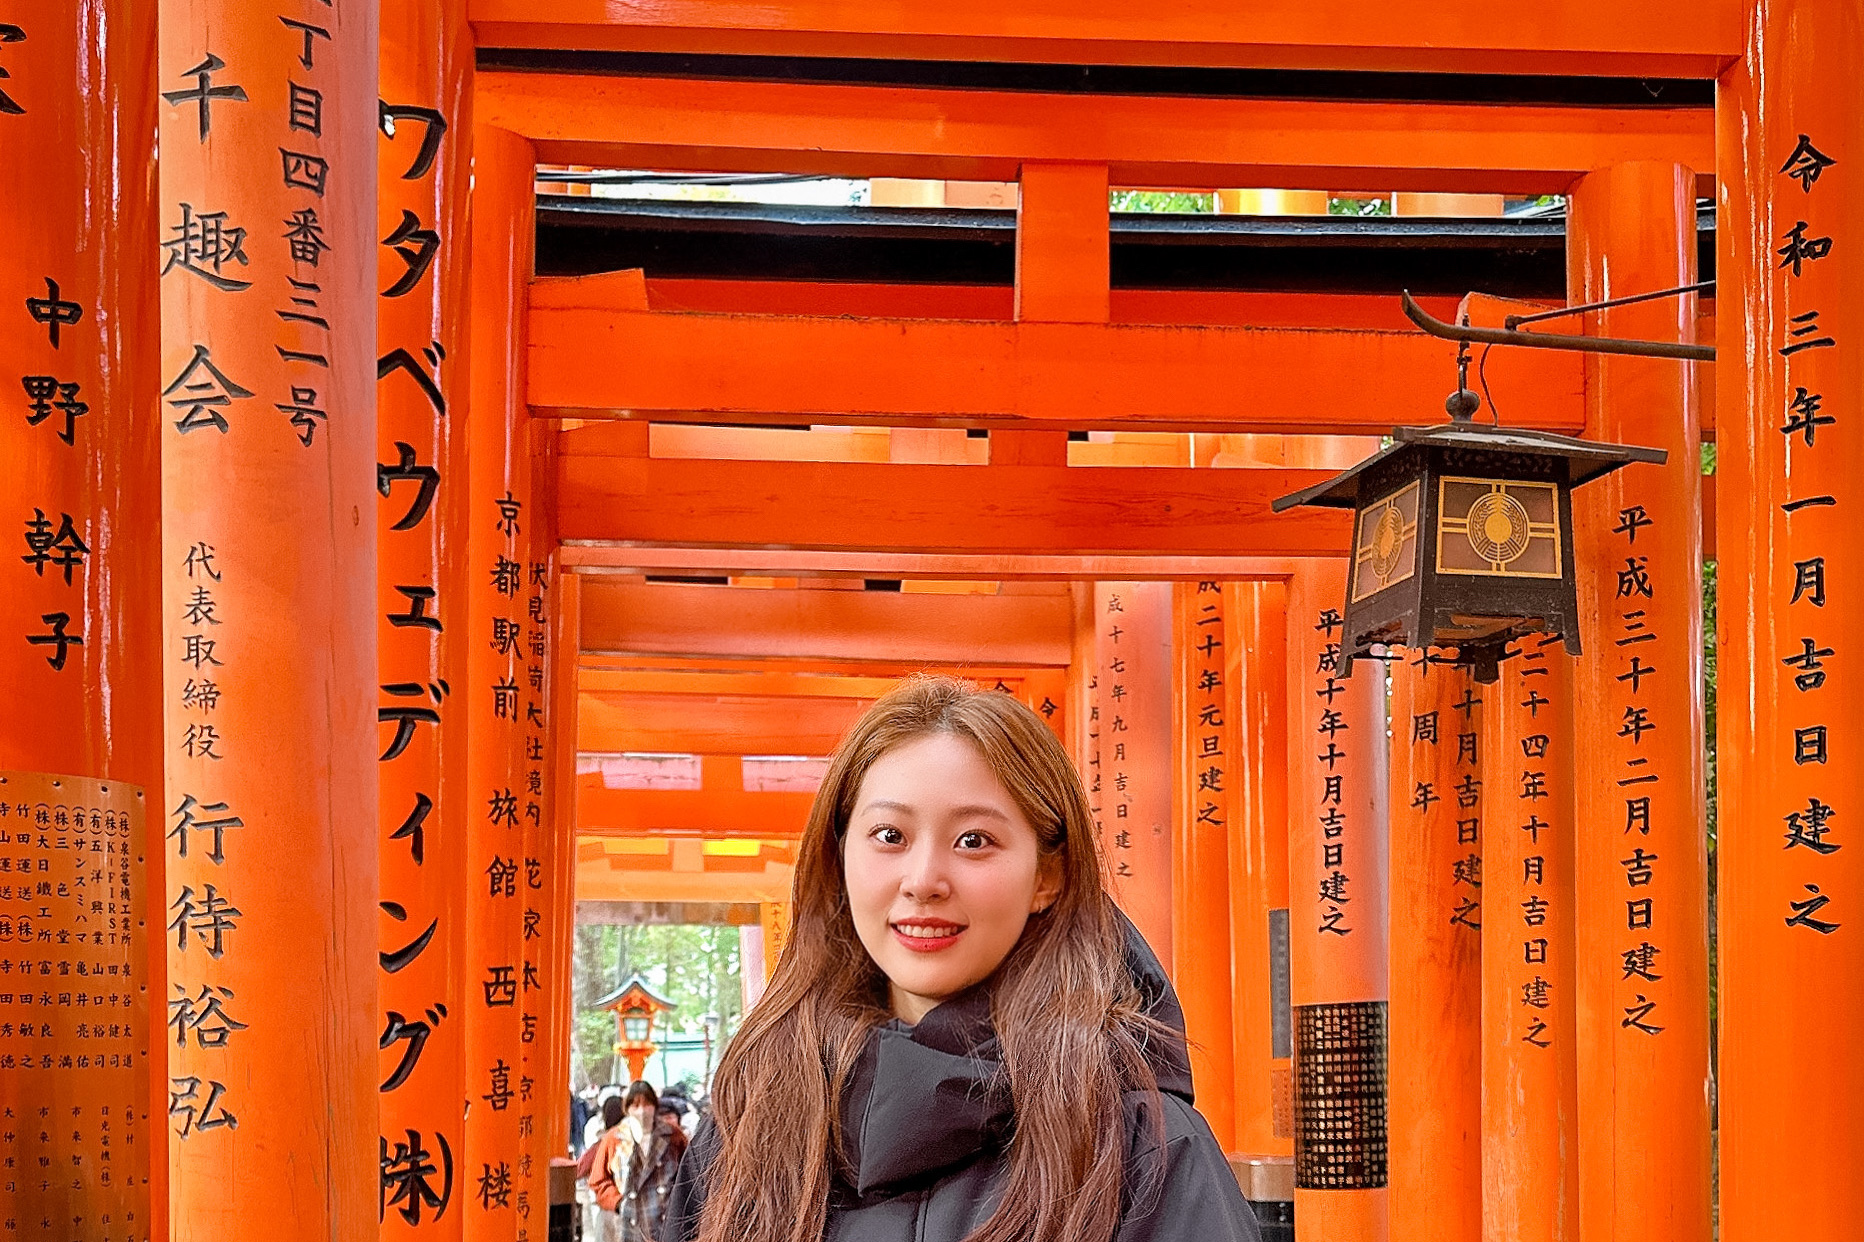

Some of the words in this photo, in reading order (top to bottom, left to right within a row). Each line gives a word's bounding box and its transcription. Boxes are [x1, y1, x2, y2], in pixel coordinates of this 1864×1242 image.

[161, 53, 254, 432] 千趣会
[276, 0, 332, 447] 丁目四番三一号
[22, 277, 89, 446] 中野
[22, 508, 91, 671] 幹子
[491, 492, 522, 722] 京都駅前
[1777, 135, 1841, 934] 令和三年一月吉日建之
[183, 542, 221, 758] 代表取締役
[378, 99, 453, 1226] ワタベウェディング株)
[1107, 594, 1133, 878] 成十七年九月吉日建之
[16, 804, 33, 943] 竹田運送(株)
[54, 804, 70, 944] (株)三色堂
[89, 808, 103, 945] (有)五洋興業
[488, 789, 518, 896] 旅館
[1314, 608, 1352, 936] 平成十年十月吉日建之
[1518, 652, 1552, 1049] 二十四年十月吉日建之
[1613, 506, 1662, 1034] 平成三十年二月吉日建之
[19, 960, 34, 1068] 竹田敏之
[38, 960, 54, 1068] 富永良吾
[93, 962, 105, 1068] 山口裕司
[108, 964, 120, 1068] 田中健司
[164, 793, 249, 1137] 行待裕弘
[479, 966, 516, 1208] 西喜楼
